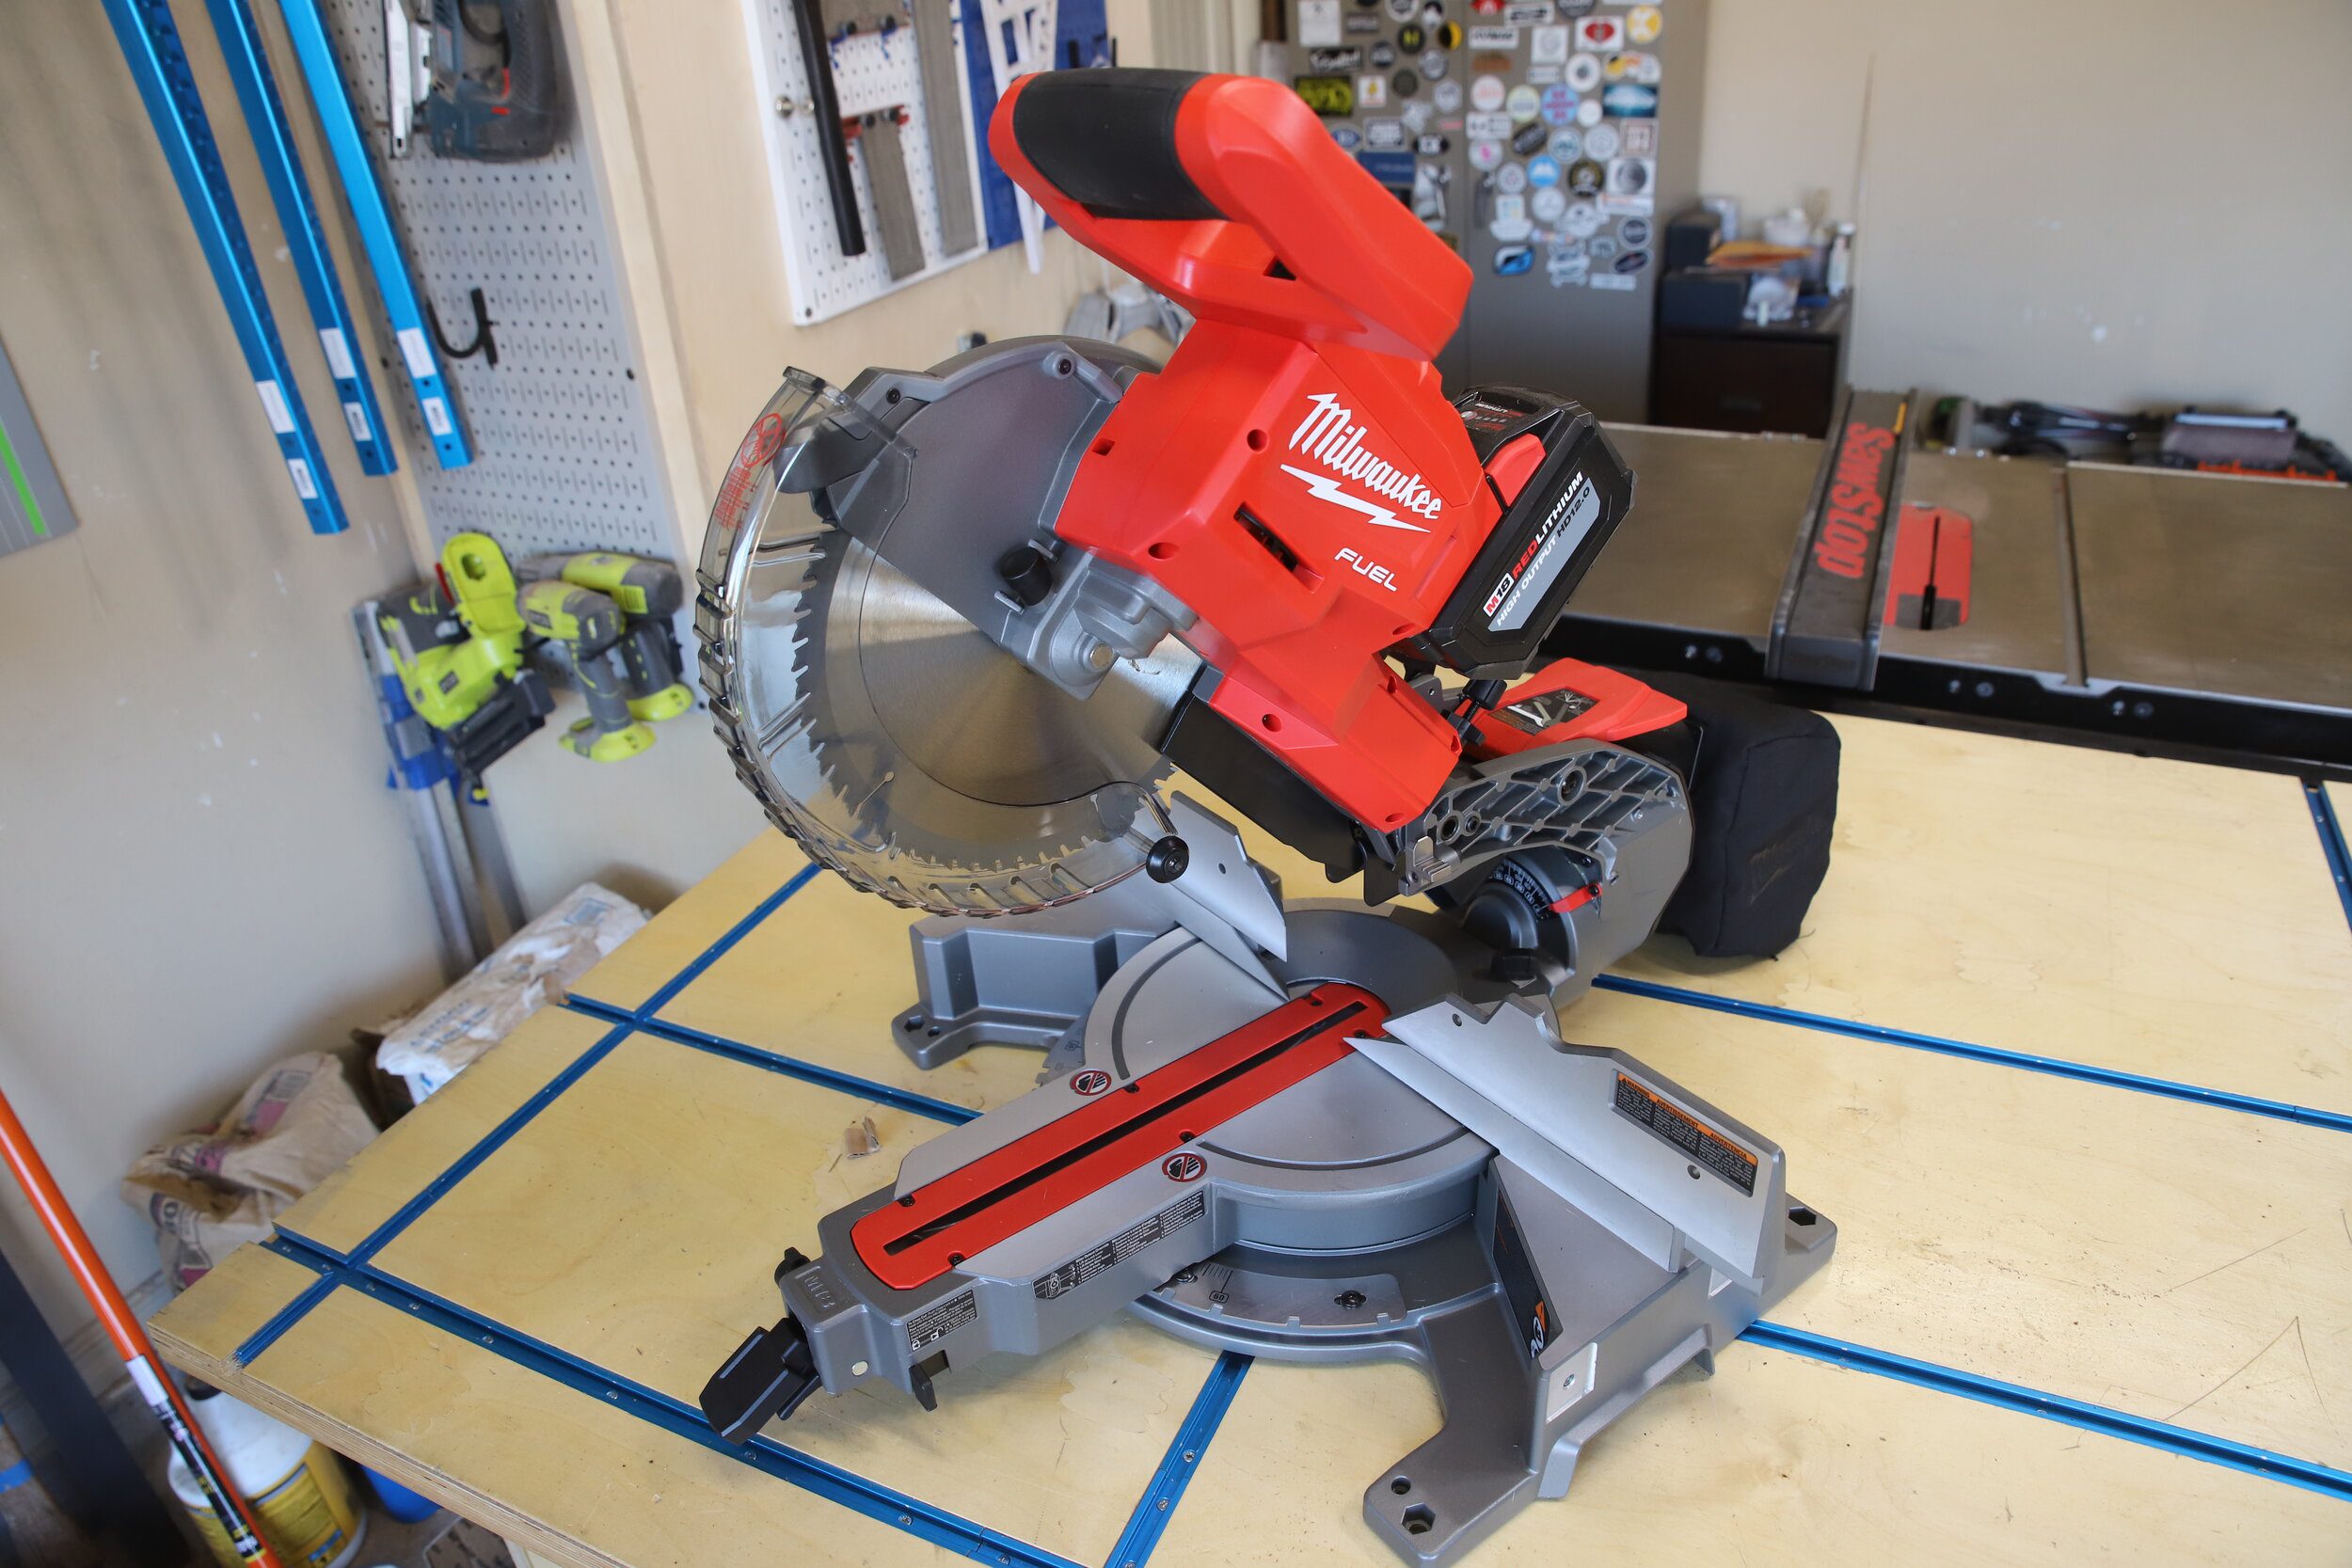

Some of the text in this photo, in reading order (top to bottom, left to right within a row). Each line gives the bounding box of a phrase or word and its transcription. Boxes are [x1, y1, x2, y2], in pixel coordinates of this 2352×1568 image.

[1288, 392, 1442, 520] Milwaukee
[1814, 422, 1896, 579] SawStop
[1486, 470, 1583, 613] M18 REDLITHIUM
[1496, 486, 1590, 626] HIGH OUTPUT HD12.0
[1334, 547, 1398, 592] FUEL
[1627, 1081, 1650, 1099] WARNING
[1656, 1099, 1699, 1129] AVERTISSEMENT
[1709, 1132, 1747, 1159] ADVERTENCIA
[1214, 1292, 1225, 1301] 60
